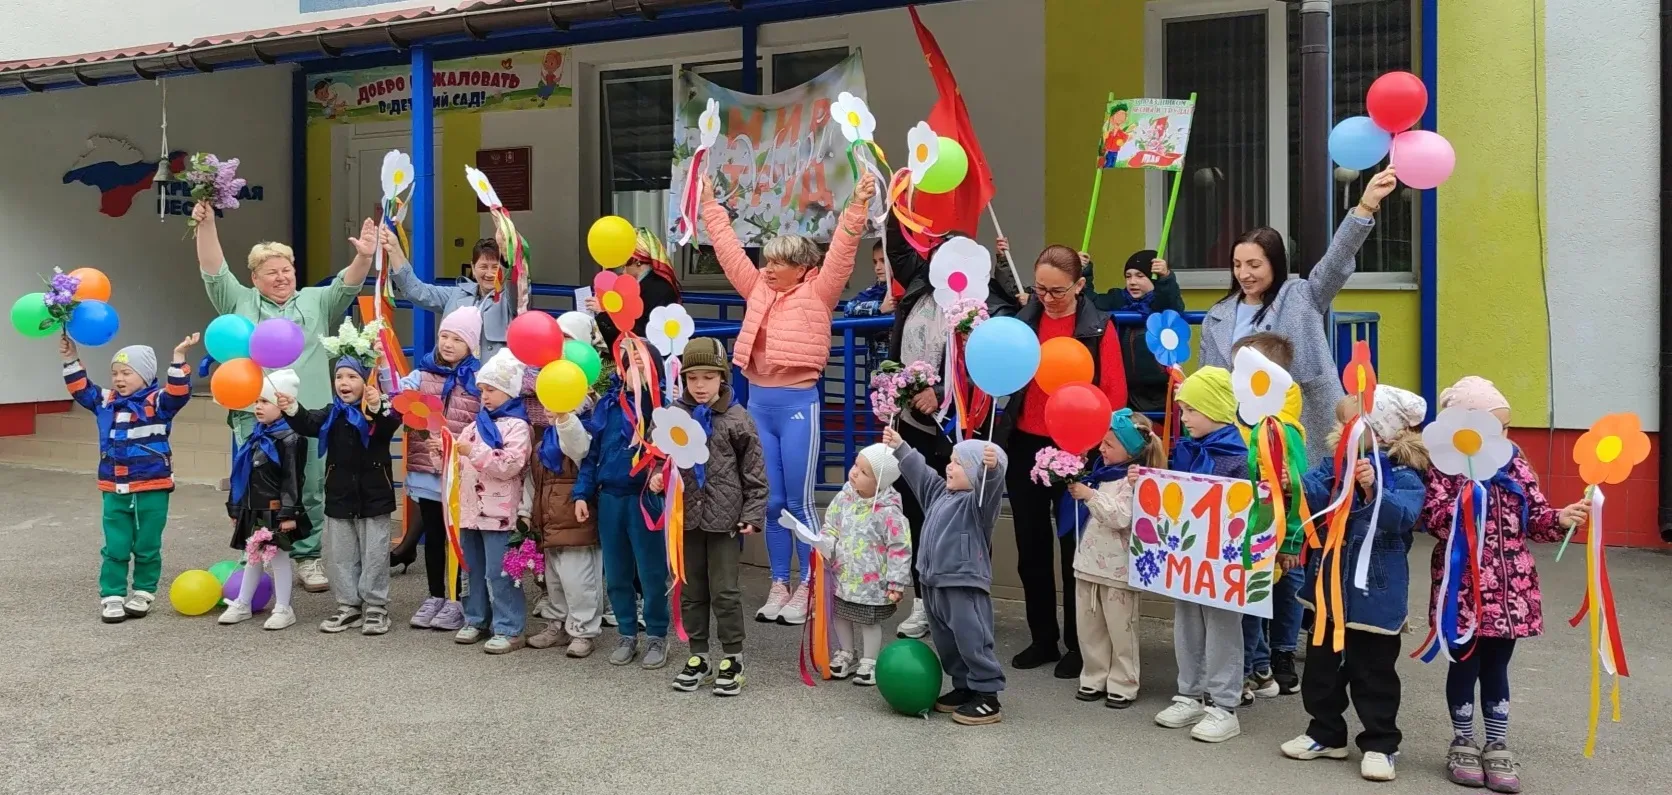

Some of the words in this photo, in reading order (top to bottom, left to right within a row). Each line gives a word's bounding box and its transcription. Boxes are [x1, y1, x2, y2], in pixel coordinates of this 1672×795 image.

[357, 76, 405, 106] ДОБРО
[409, 70, 521, 89] ЖАЛОВАТЬ
[452, 91, 486, 108] САД!
[727, 98, 833, 151] МИР
[1191, 483, 1223, 560] 1
[1165, 553, 1246, 607] МАЯ
